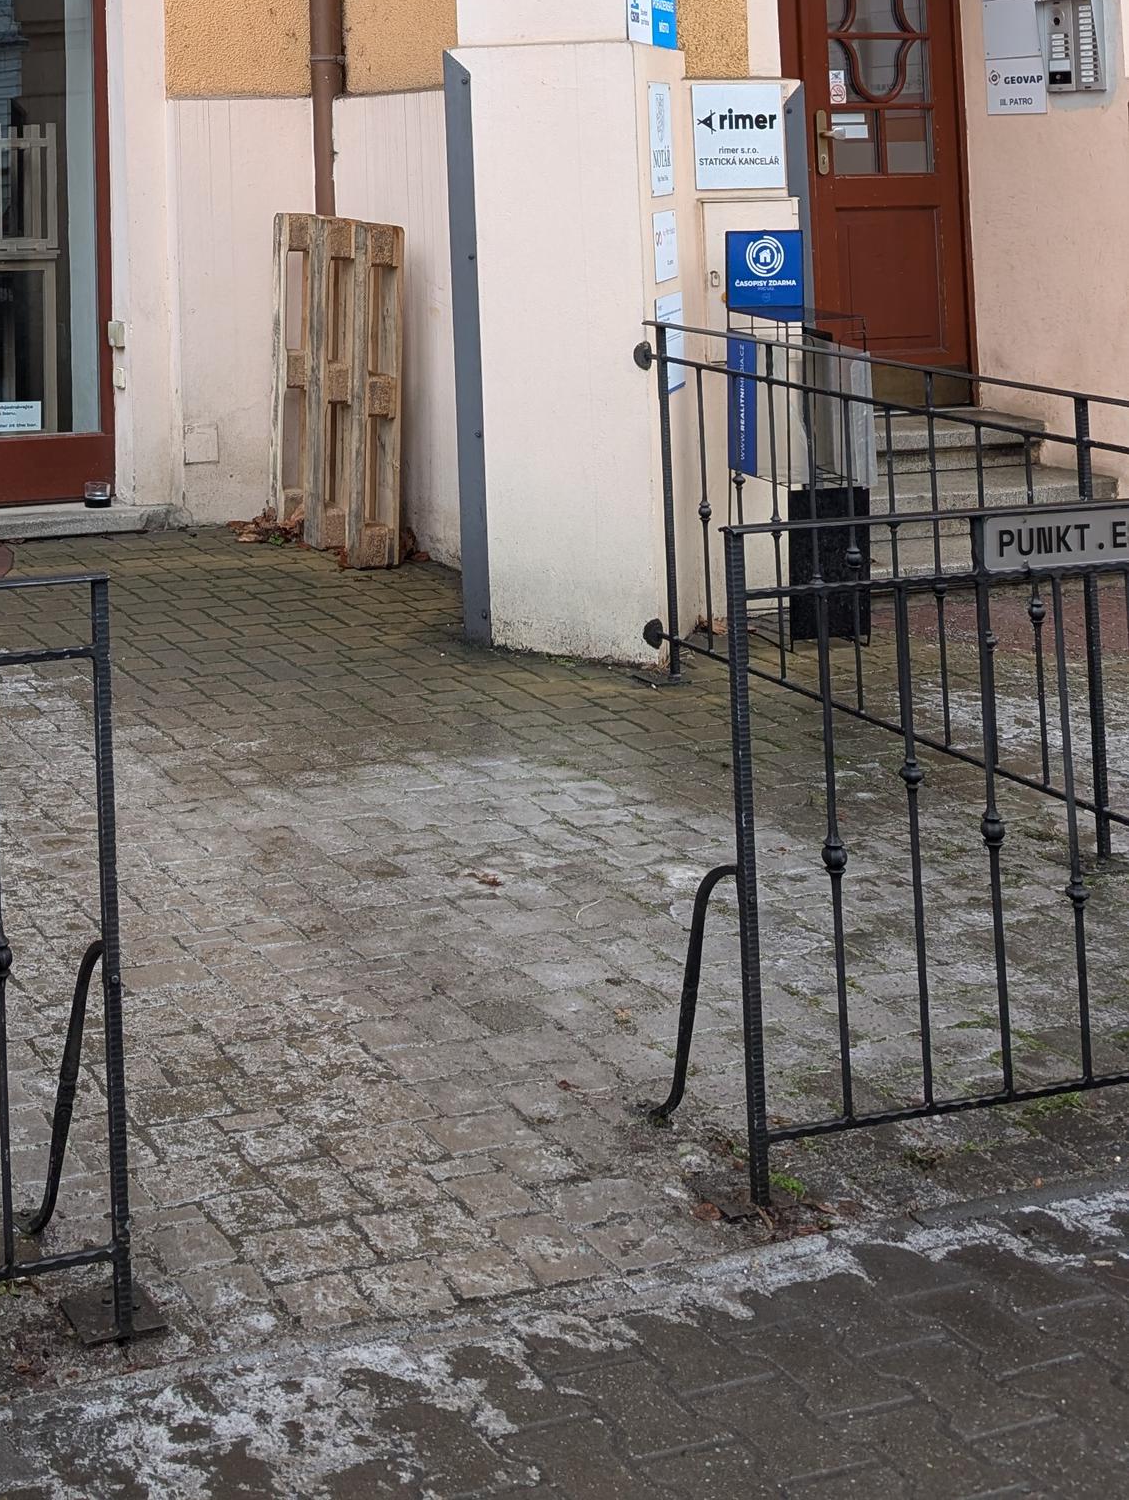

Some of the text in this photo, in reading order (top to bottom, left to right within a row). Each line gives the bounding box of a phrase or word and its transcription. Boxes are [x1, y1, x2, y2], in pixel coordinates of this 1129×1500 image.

[1004, 75, 1043, 85] GEOVAP
[1009, 97, 1033, 106] PATRO
[719, 107, 777, 130] rimer
[718, 145, 760, 155] rimer s.r.o.
[699, 155, 780, 166] STATICKÁ KANCELÁŘ
[734, 279, 797, 288] ČASOPISY ZDARMA
